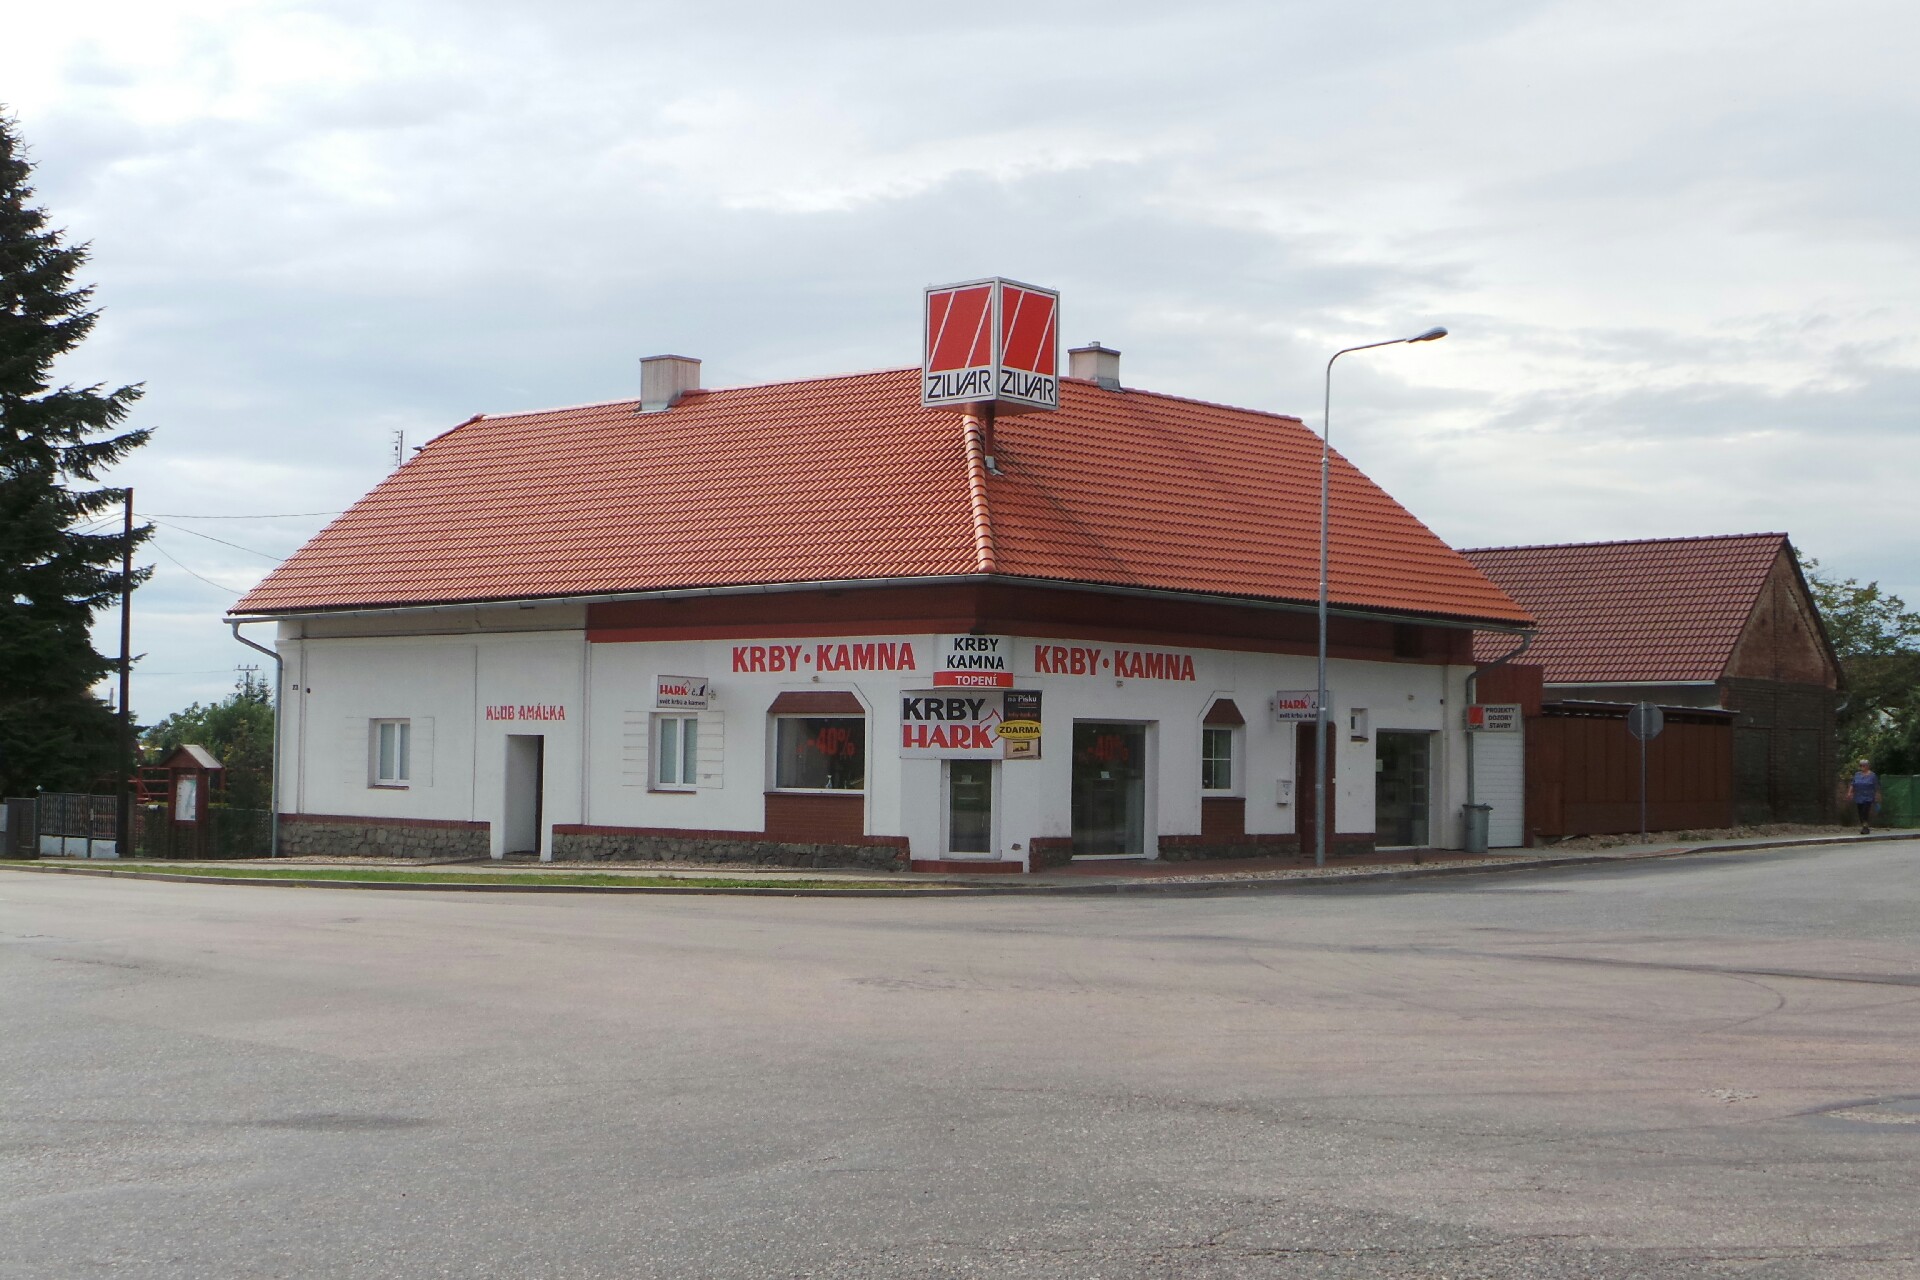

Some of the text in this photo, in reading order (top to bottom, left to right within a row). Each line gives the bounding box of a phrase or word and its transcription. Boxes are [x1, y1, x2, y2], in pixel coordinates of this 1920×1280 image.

[928, 369, 991, 398] ZILVAR
[1001, 369, 1054, 402] ZILVAR
[954, 637, 999, 652] KRBY
[733, 643, 916, 672] KRBY KAMNA
[946, 654, 1005, 670] KAMNA
[1034, 644, 1196, 681] KRBY KAMNA
[955, 673, 998, 686] TOPENÍ
[660, 684, 687, 696] HARK
[486, 702, 566, 721] KLUB AMÁLKA
[903, 698, 986, 721] KRBY
[1280, 700, 1307, 709] HARK
[902, 724, 994, 749] HARK
[999, 726, 1040, 734] ZDARMA
